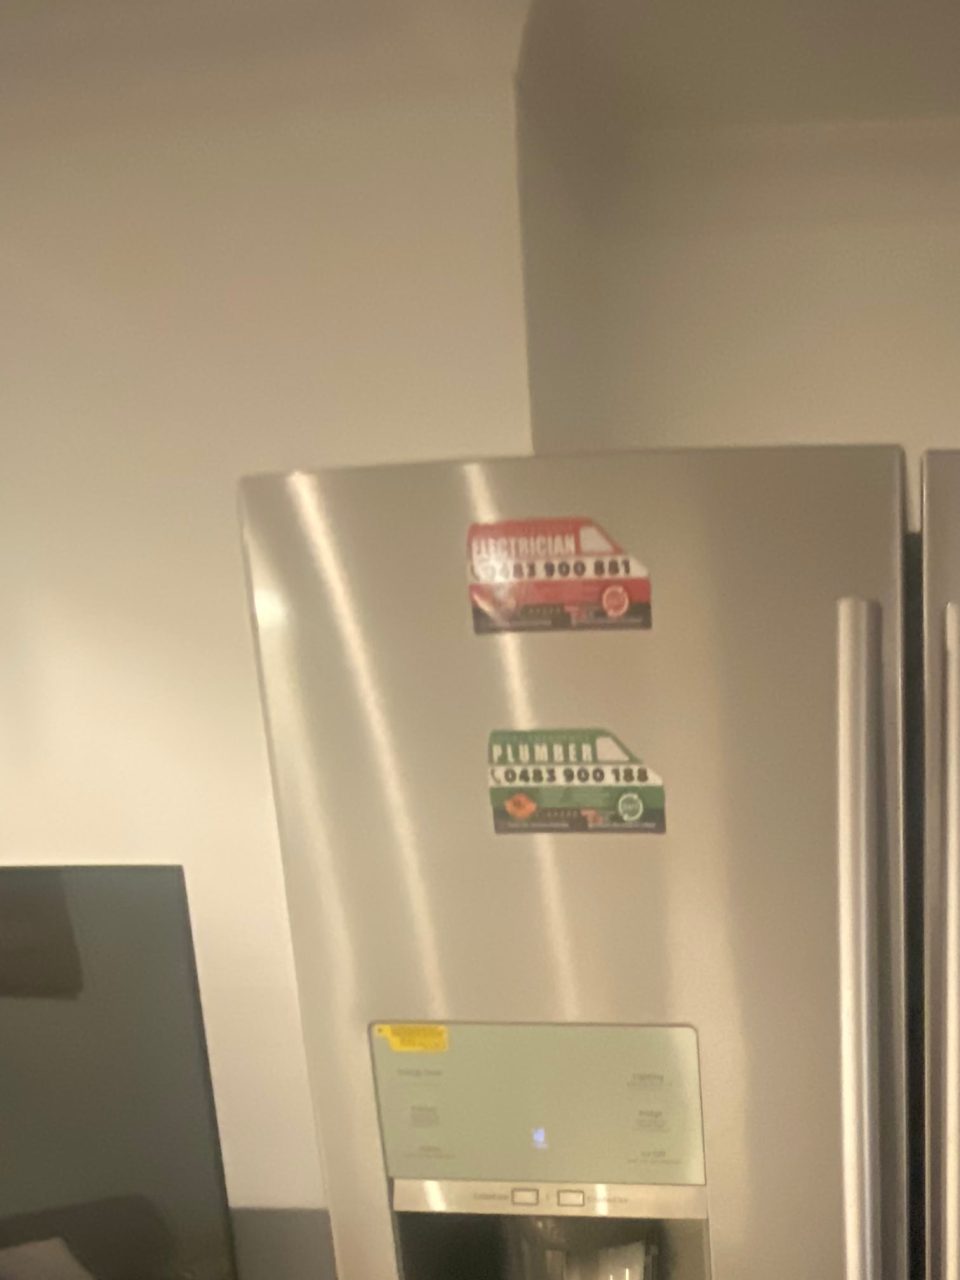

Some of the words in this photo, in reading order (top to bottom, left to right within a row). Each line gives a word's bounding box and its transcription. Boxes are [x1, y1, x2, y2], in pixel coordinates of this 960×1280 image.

[472, 533, 576, 561] ELECTRICIAN
[544, 561, 586, 577] 900
[492, 742, 592, 763] PLUMBER
[504, 767, 556, 783] 0483
[563, 767, 605, 783] 900
[611, 767, 649, 783] 188
